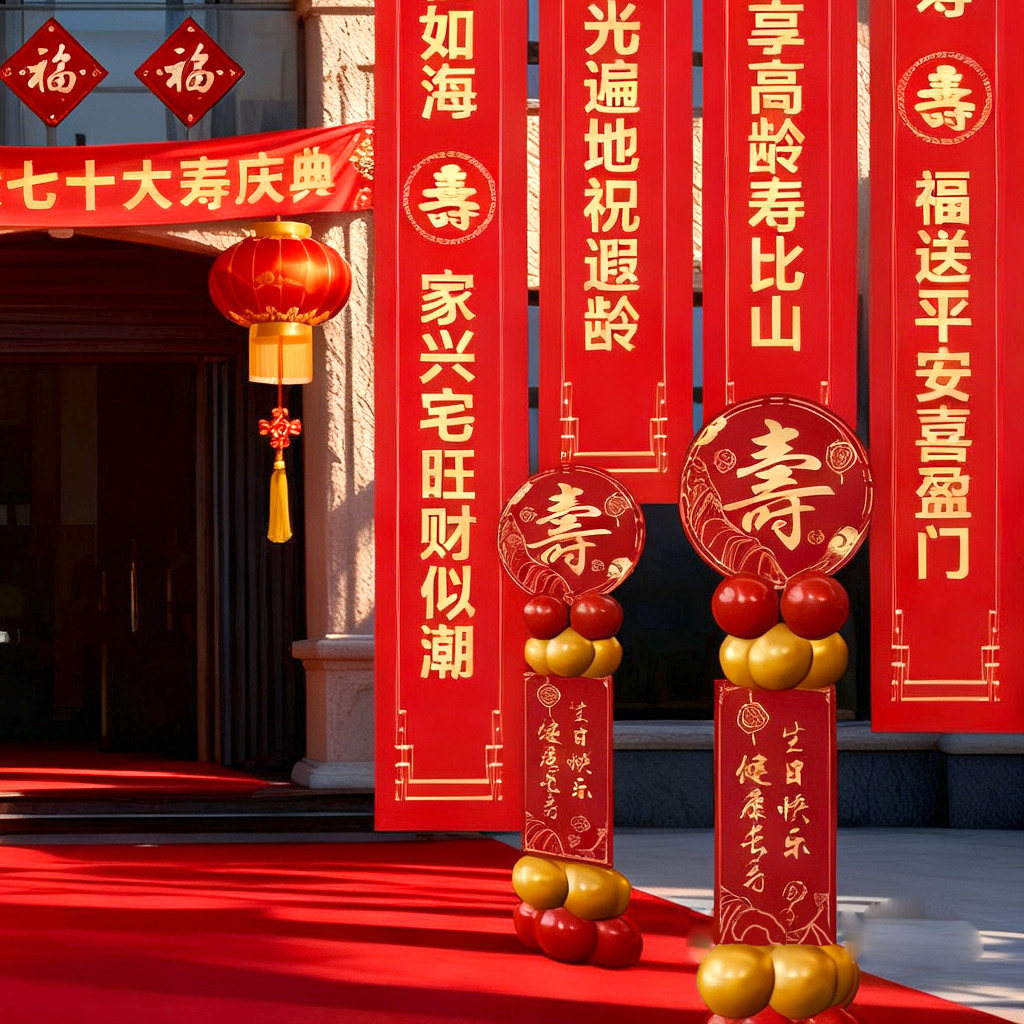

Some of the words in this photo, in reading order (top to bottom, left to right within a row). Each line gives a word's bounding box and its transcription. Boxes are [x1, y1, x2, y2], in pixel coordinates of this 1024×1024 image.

[26, 44, 76, 93] 福
[164, 43, 215, 94] 福
[420, 269, 476, 679] 家兴宅旺财似潮
[915, 171, 972, 579] 福送平安喜盈门
